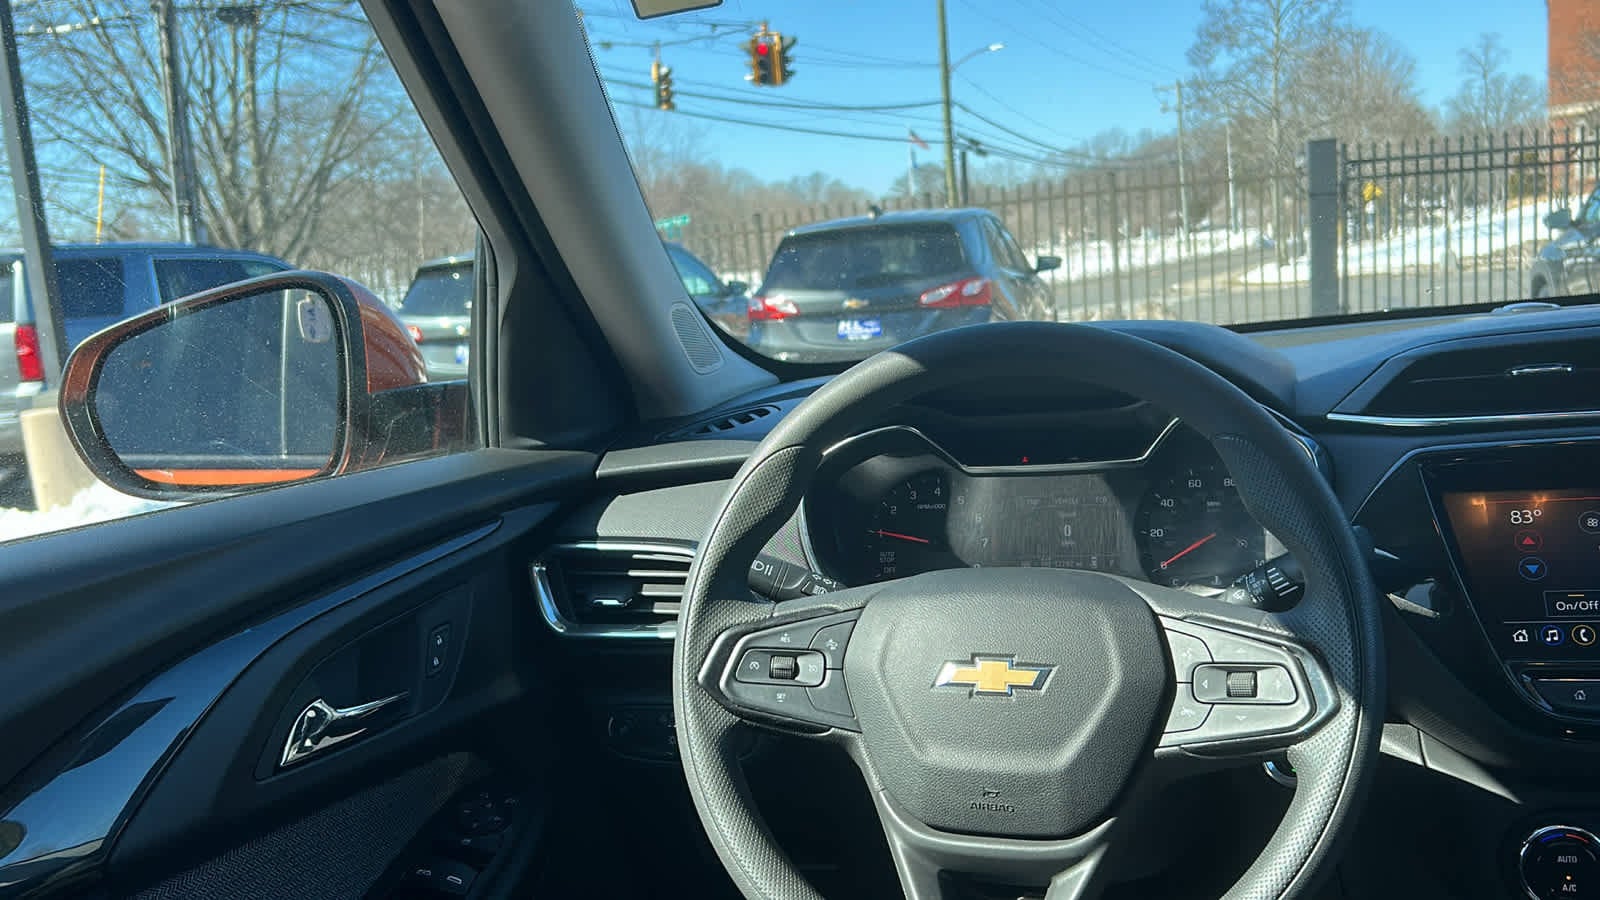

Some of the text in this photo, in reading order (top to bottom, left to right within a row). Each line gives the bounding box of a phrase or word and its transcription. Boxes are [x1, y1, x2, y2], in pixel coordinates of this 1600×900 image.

[1188, 479, 1202, 488] 60
[909, 490, 917, 500] 3
[934, 487, 941, 496] 4
[957, 495, 965, 505] 5
[1160, 499, 1174, 508] 40
[890, 505, 897, 515] 2
[1063, 524, 1072, 537] 0
[1150, 528, 1164, 538] 20
[981, 537, 988, 548] 7
[1555, 600, 1600, 612] On/Off
[970, 801, 1015, 813] AIRBAG
[1557, 855, 1578, 863] AUTO
[1562, 883, 1577, 892] A/C
